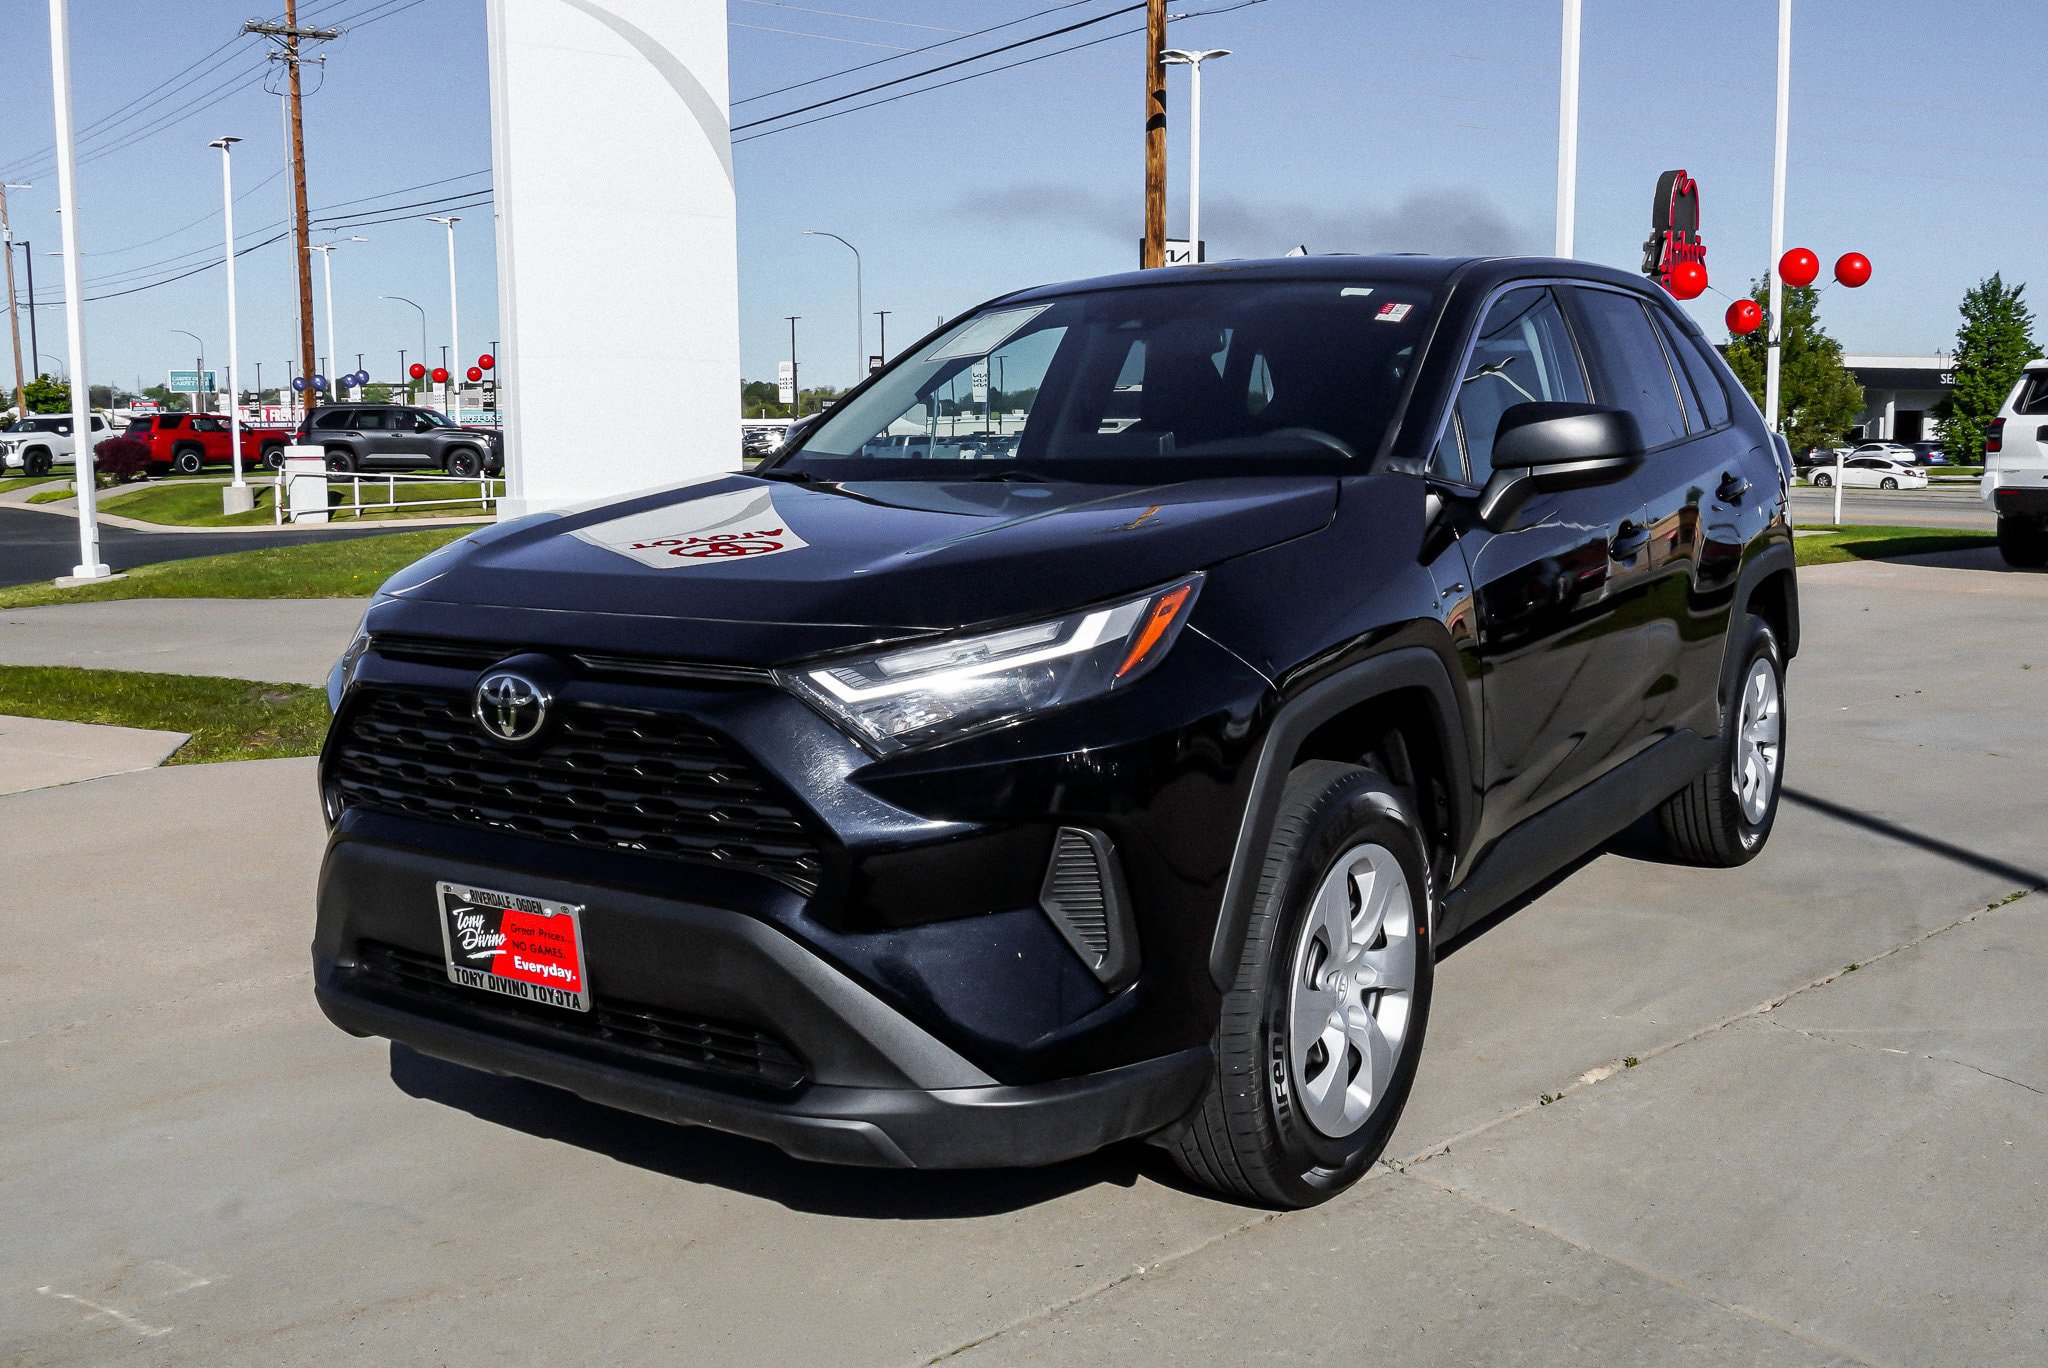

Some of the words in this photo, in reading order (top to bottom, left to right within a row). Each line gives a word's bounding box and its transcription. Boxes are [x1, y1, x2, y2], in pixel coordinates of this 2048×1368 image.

[469, 889, 512, 909] RIVERDALE
[516, 897, 543, 914] OGDEN
[453, 907, 485, 934] Tony
[510, 923, 535, 936] Great
[457, 928, 507, 950] Divino
[511, 940, 526, 950] NO
[513, 955, 576, 982] Everyday.
[454, 968, 485, 988] TONY
[488, 975, 528, 998] DIVINO
[530, 984, 581, 1009] TOYOTA
